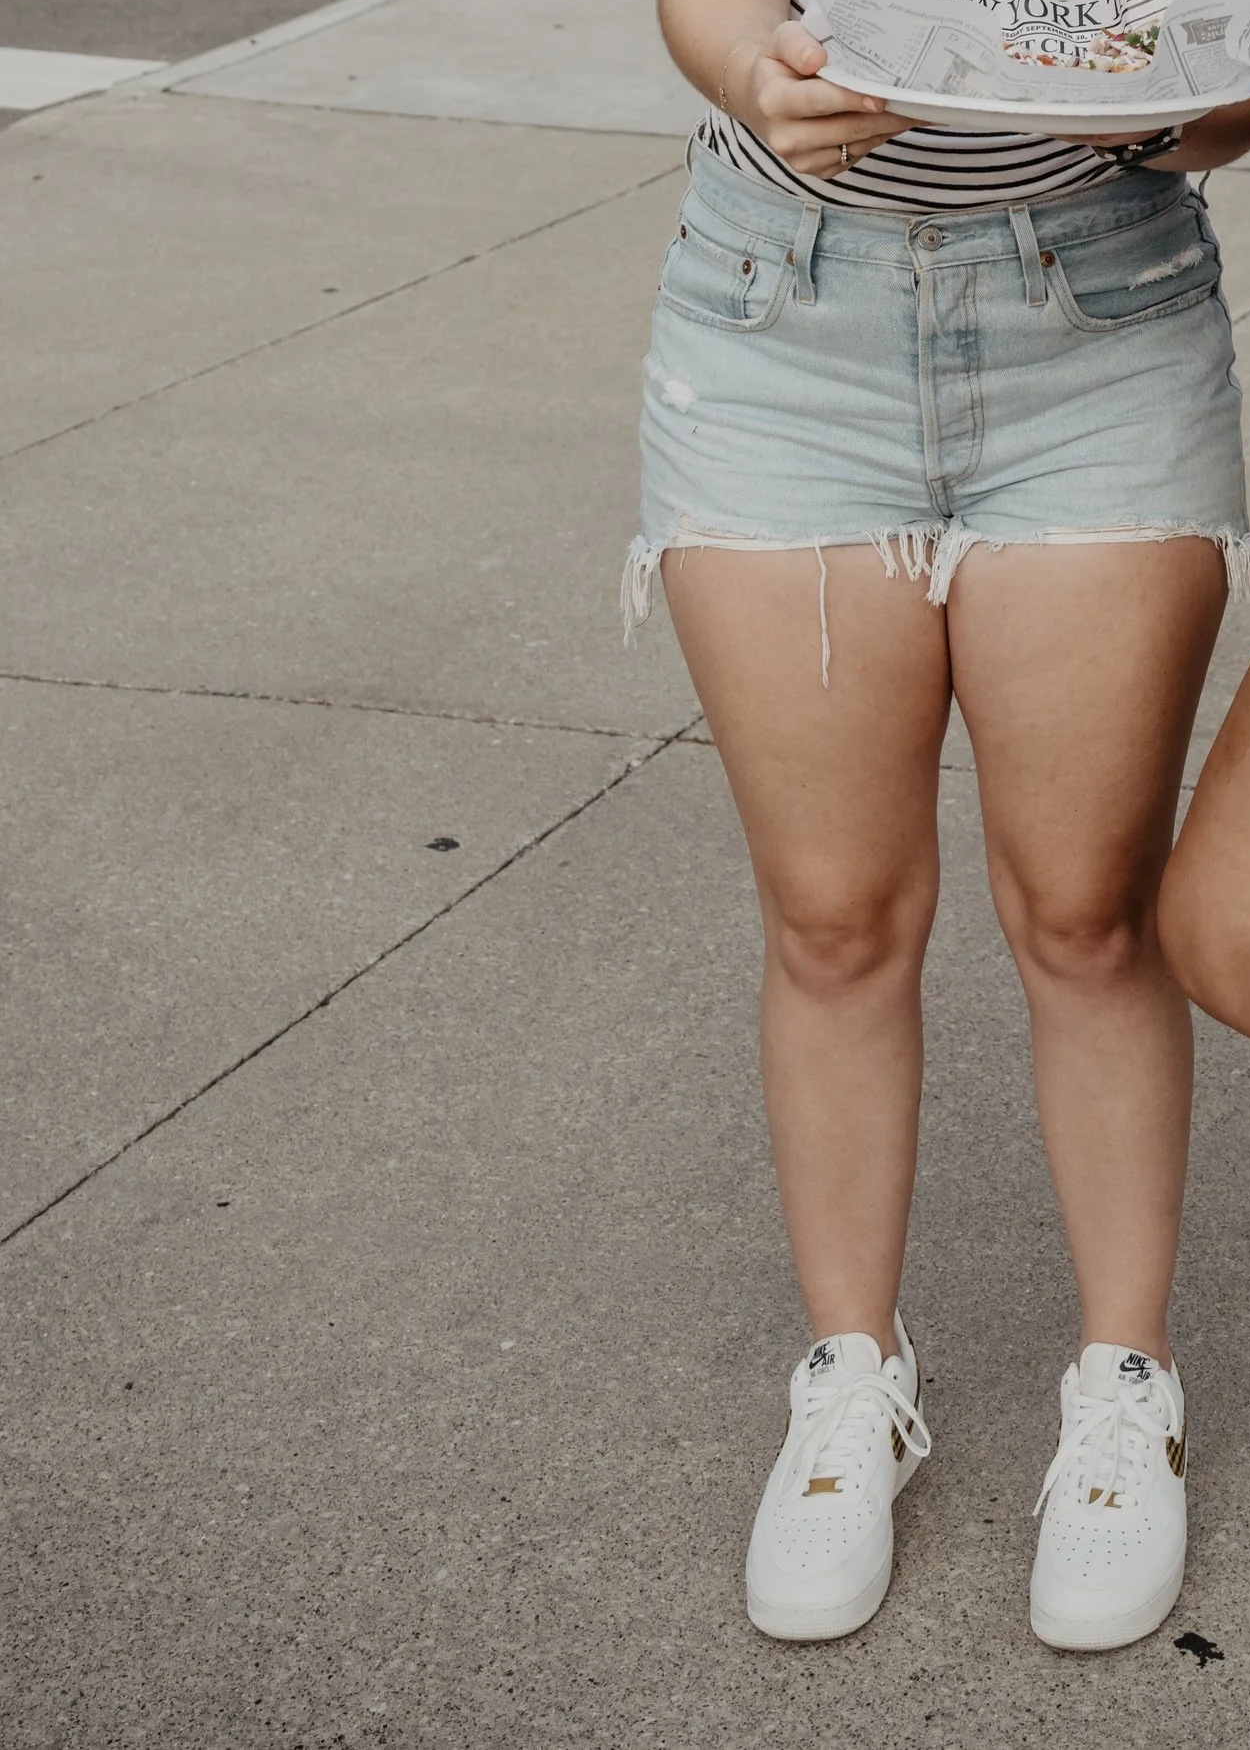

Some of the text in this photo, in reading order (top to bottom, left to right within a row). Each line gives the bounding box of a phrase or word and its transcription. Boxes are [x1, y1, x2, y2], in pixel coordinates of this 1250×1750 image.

[1026, 25, 1073, 40] SEPTEMBER
[822, 1353, 836, 1367] AIR
[1126, 1352, 1148, 1367] NIKE
[1137, 1368, 1151, 1381] AIR
